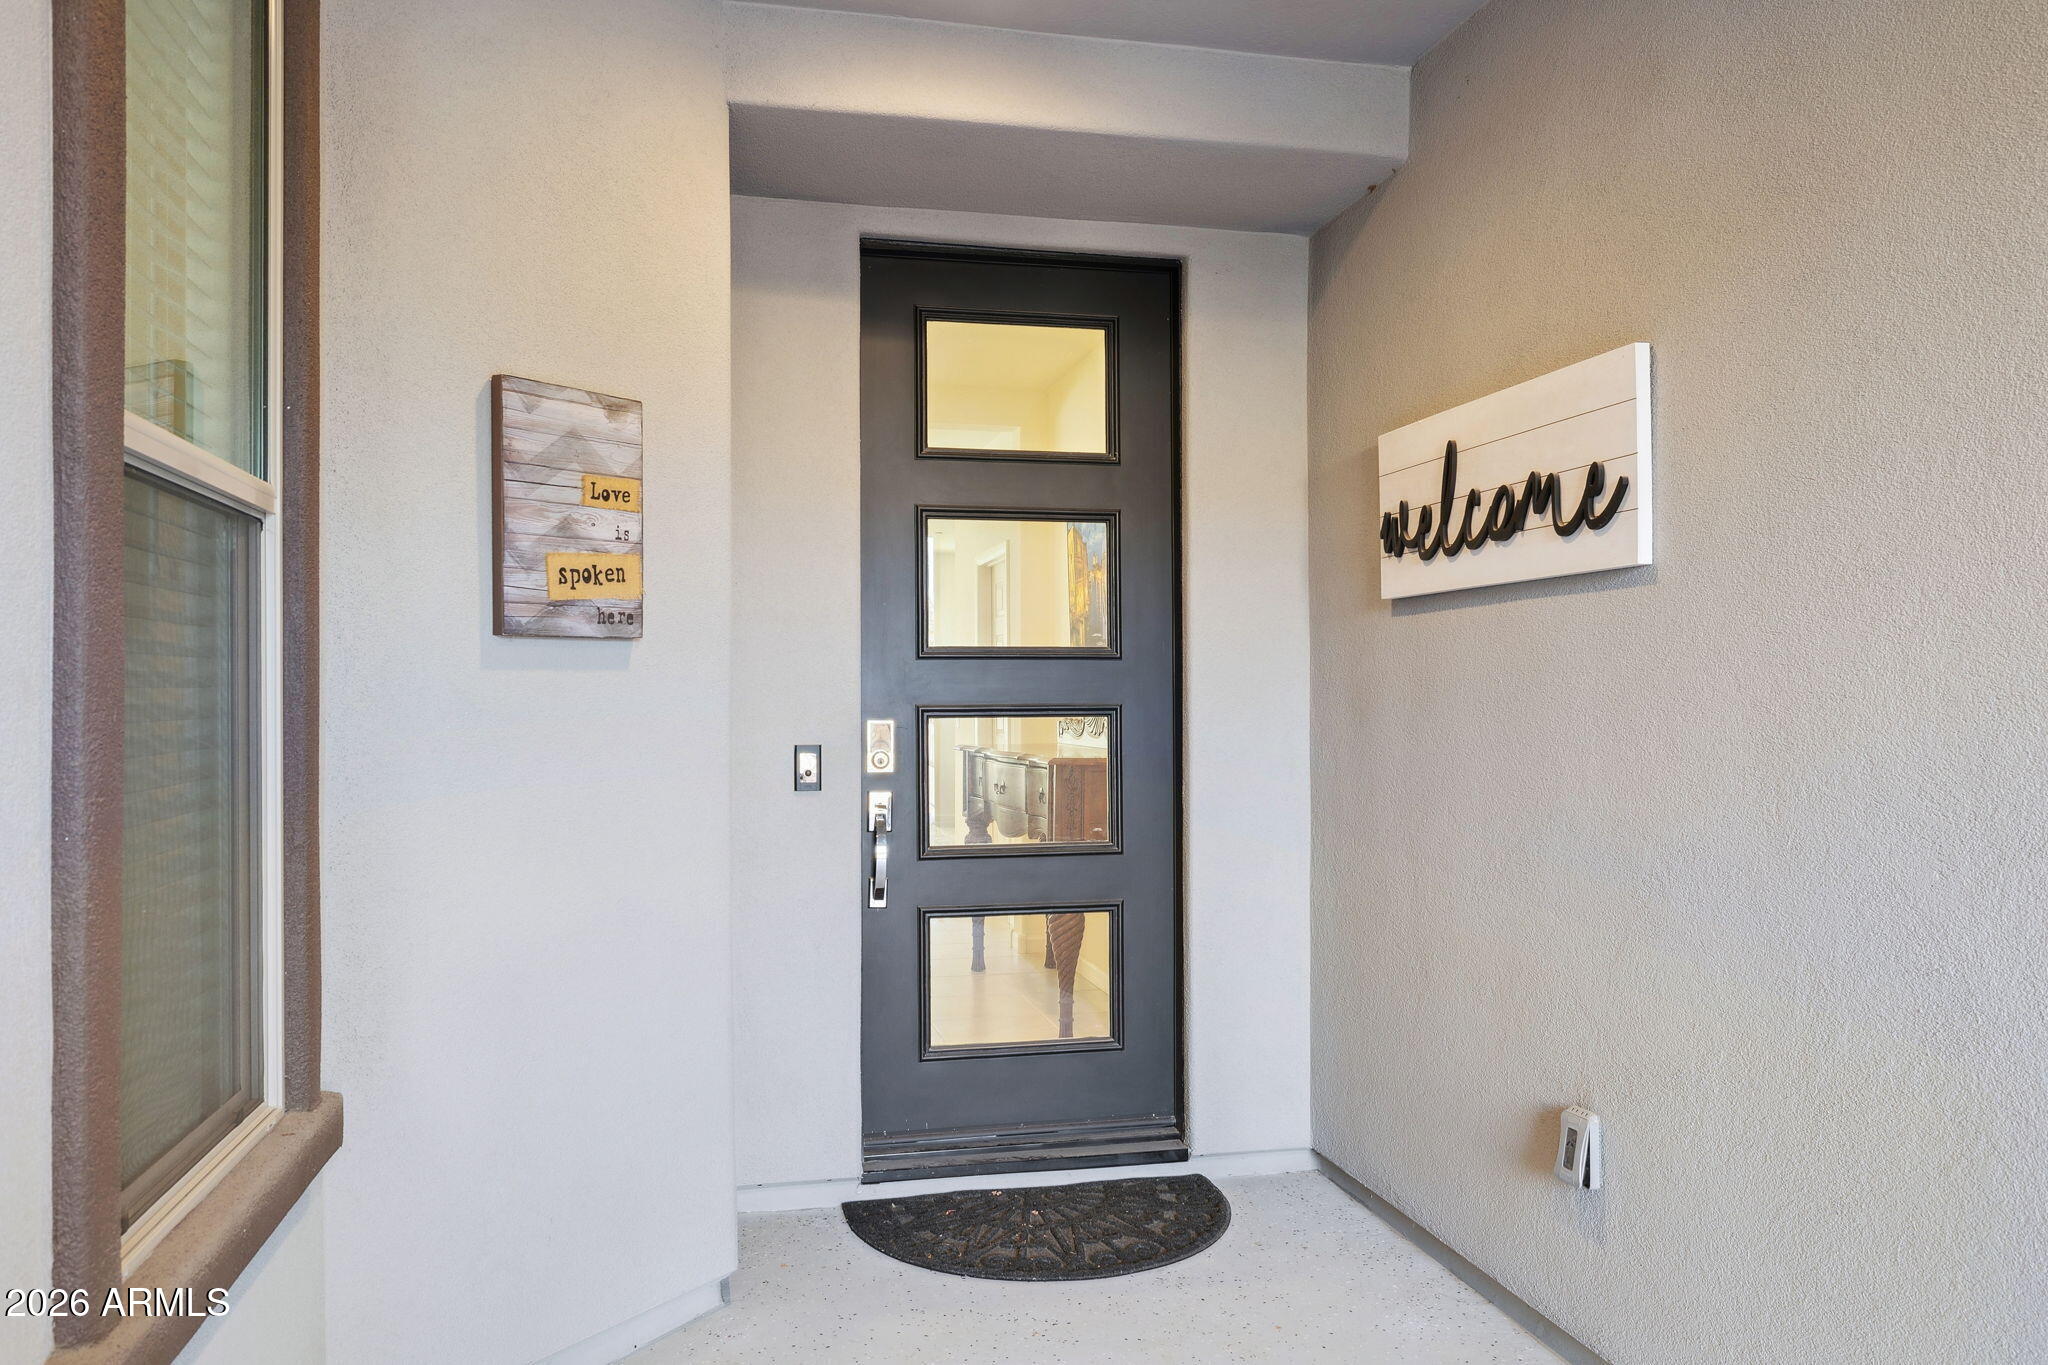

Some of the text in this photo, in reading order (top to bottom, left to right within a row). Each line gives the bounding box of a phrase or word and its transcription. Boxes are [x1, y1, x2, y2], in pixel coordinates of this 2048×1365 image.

[590, 482, 631, 503] Love
[1380, 440, 1629, 561] welcome
[615, 525, 630, 541] is
[558, 564, 626, 590] spoken
[597, 608, 634, 626] here
